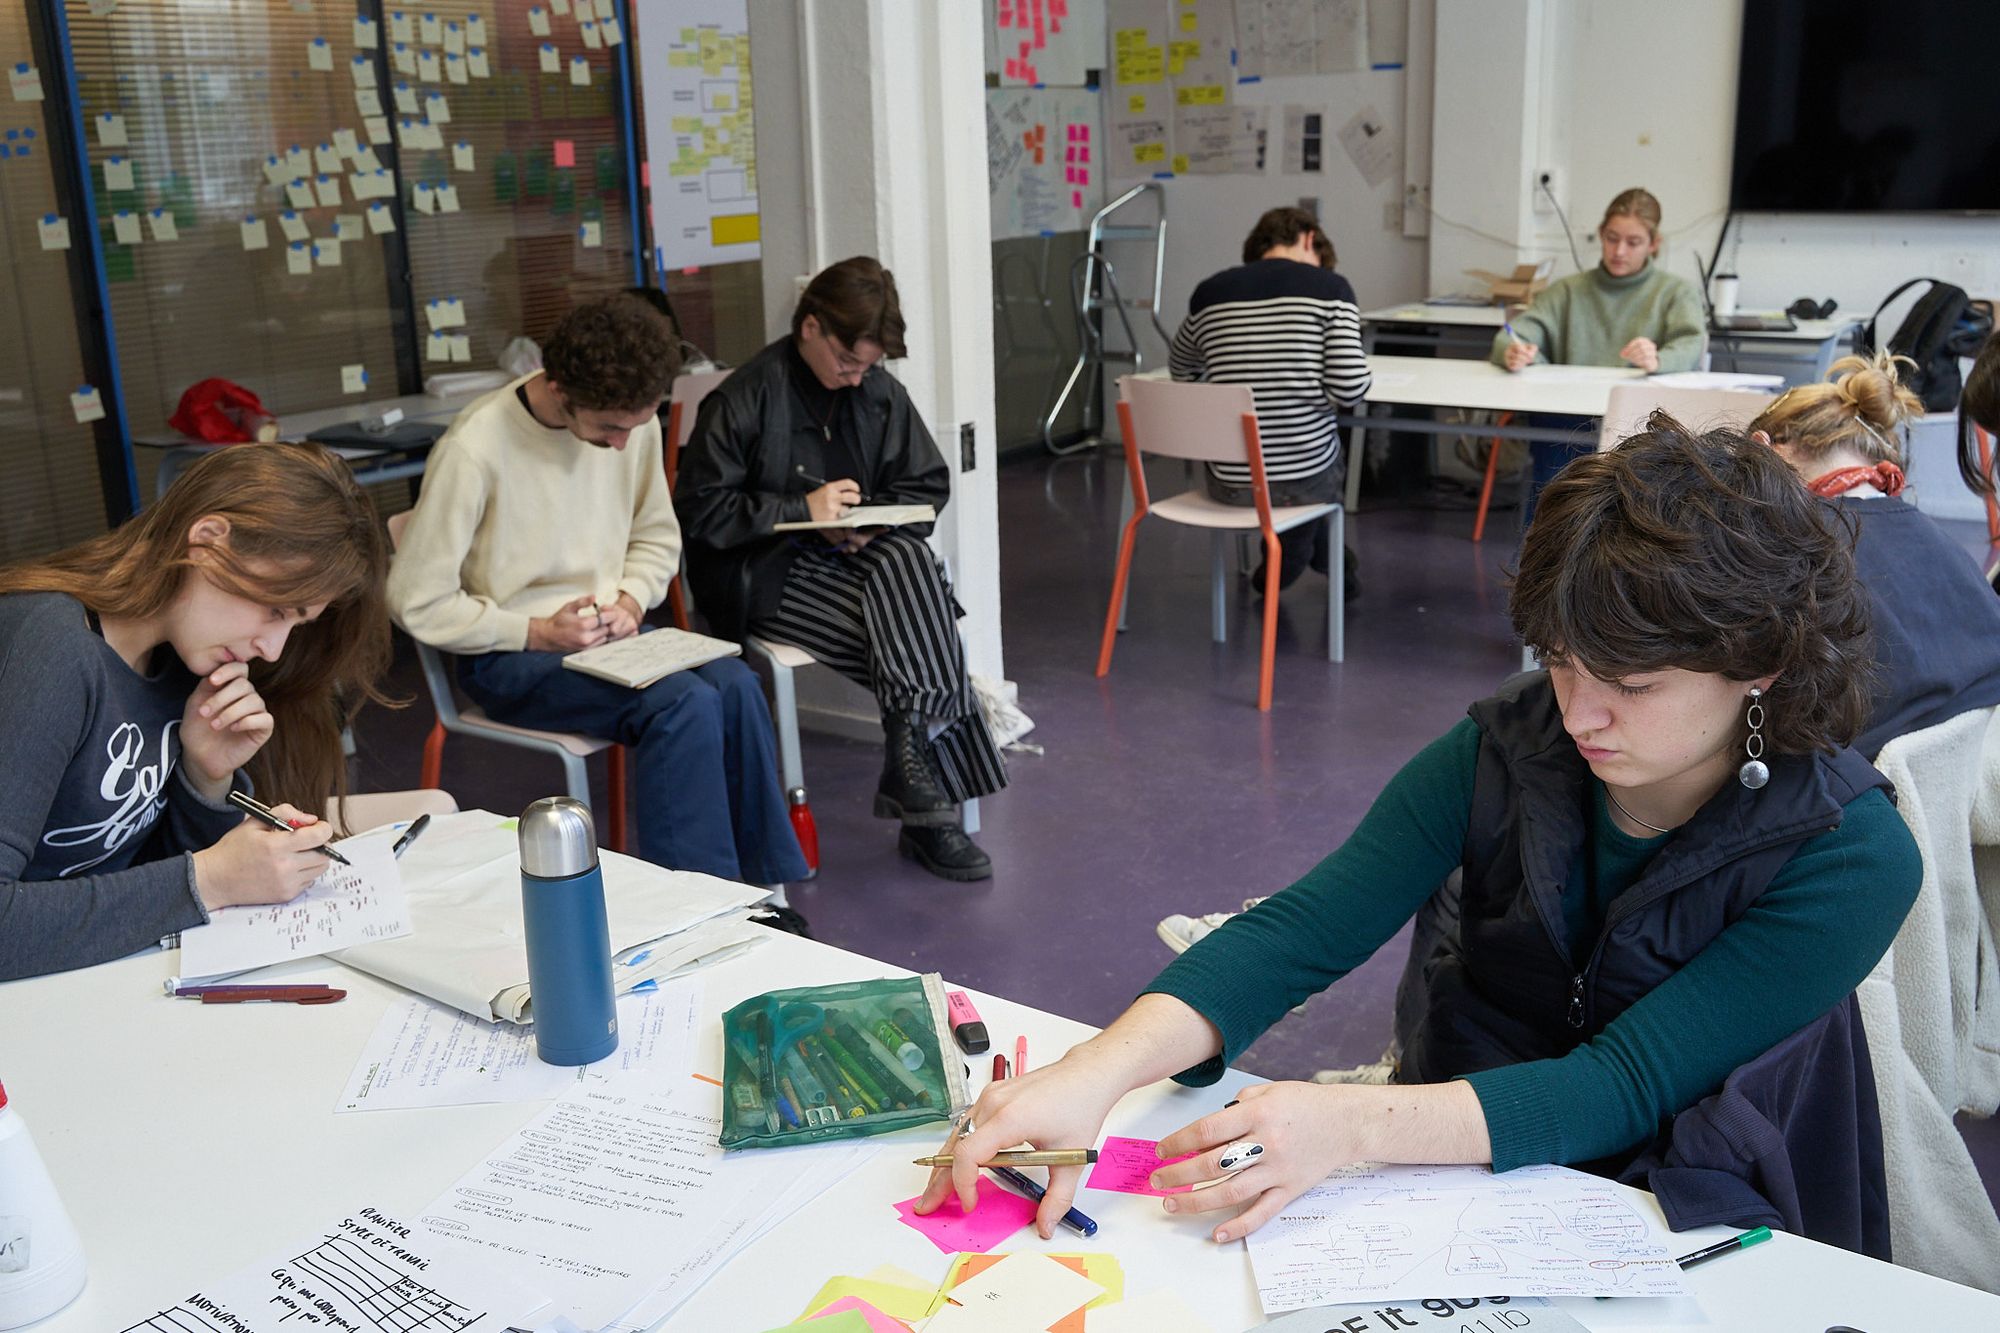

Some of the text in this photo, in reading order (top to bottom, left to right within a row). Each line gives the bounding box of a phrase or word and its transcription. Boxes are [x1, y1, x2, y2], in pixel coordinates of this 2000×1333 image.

[338, 1218, 374, 1240] STYLE
[372, 1236, 391, 1248] DE
[1373, 1307, 1419, 1330] it
